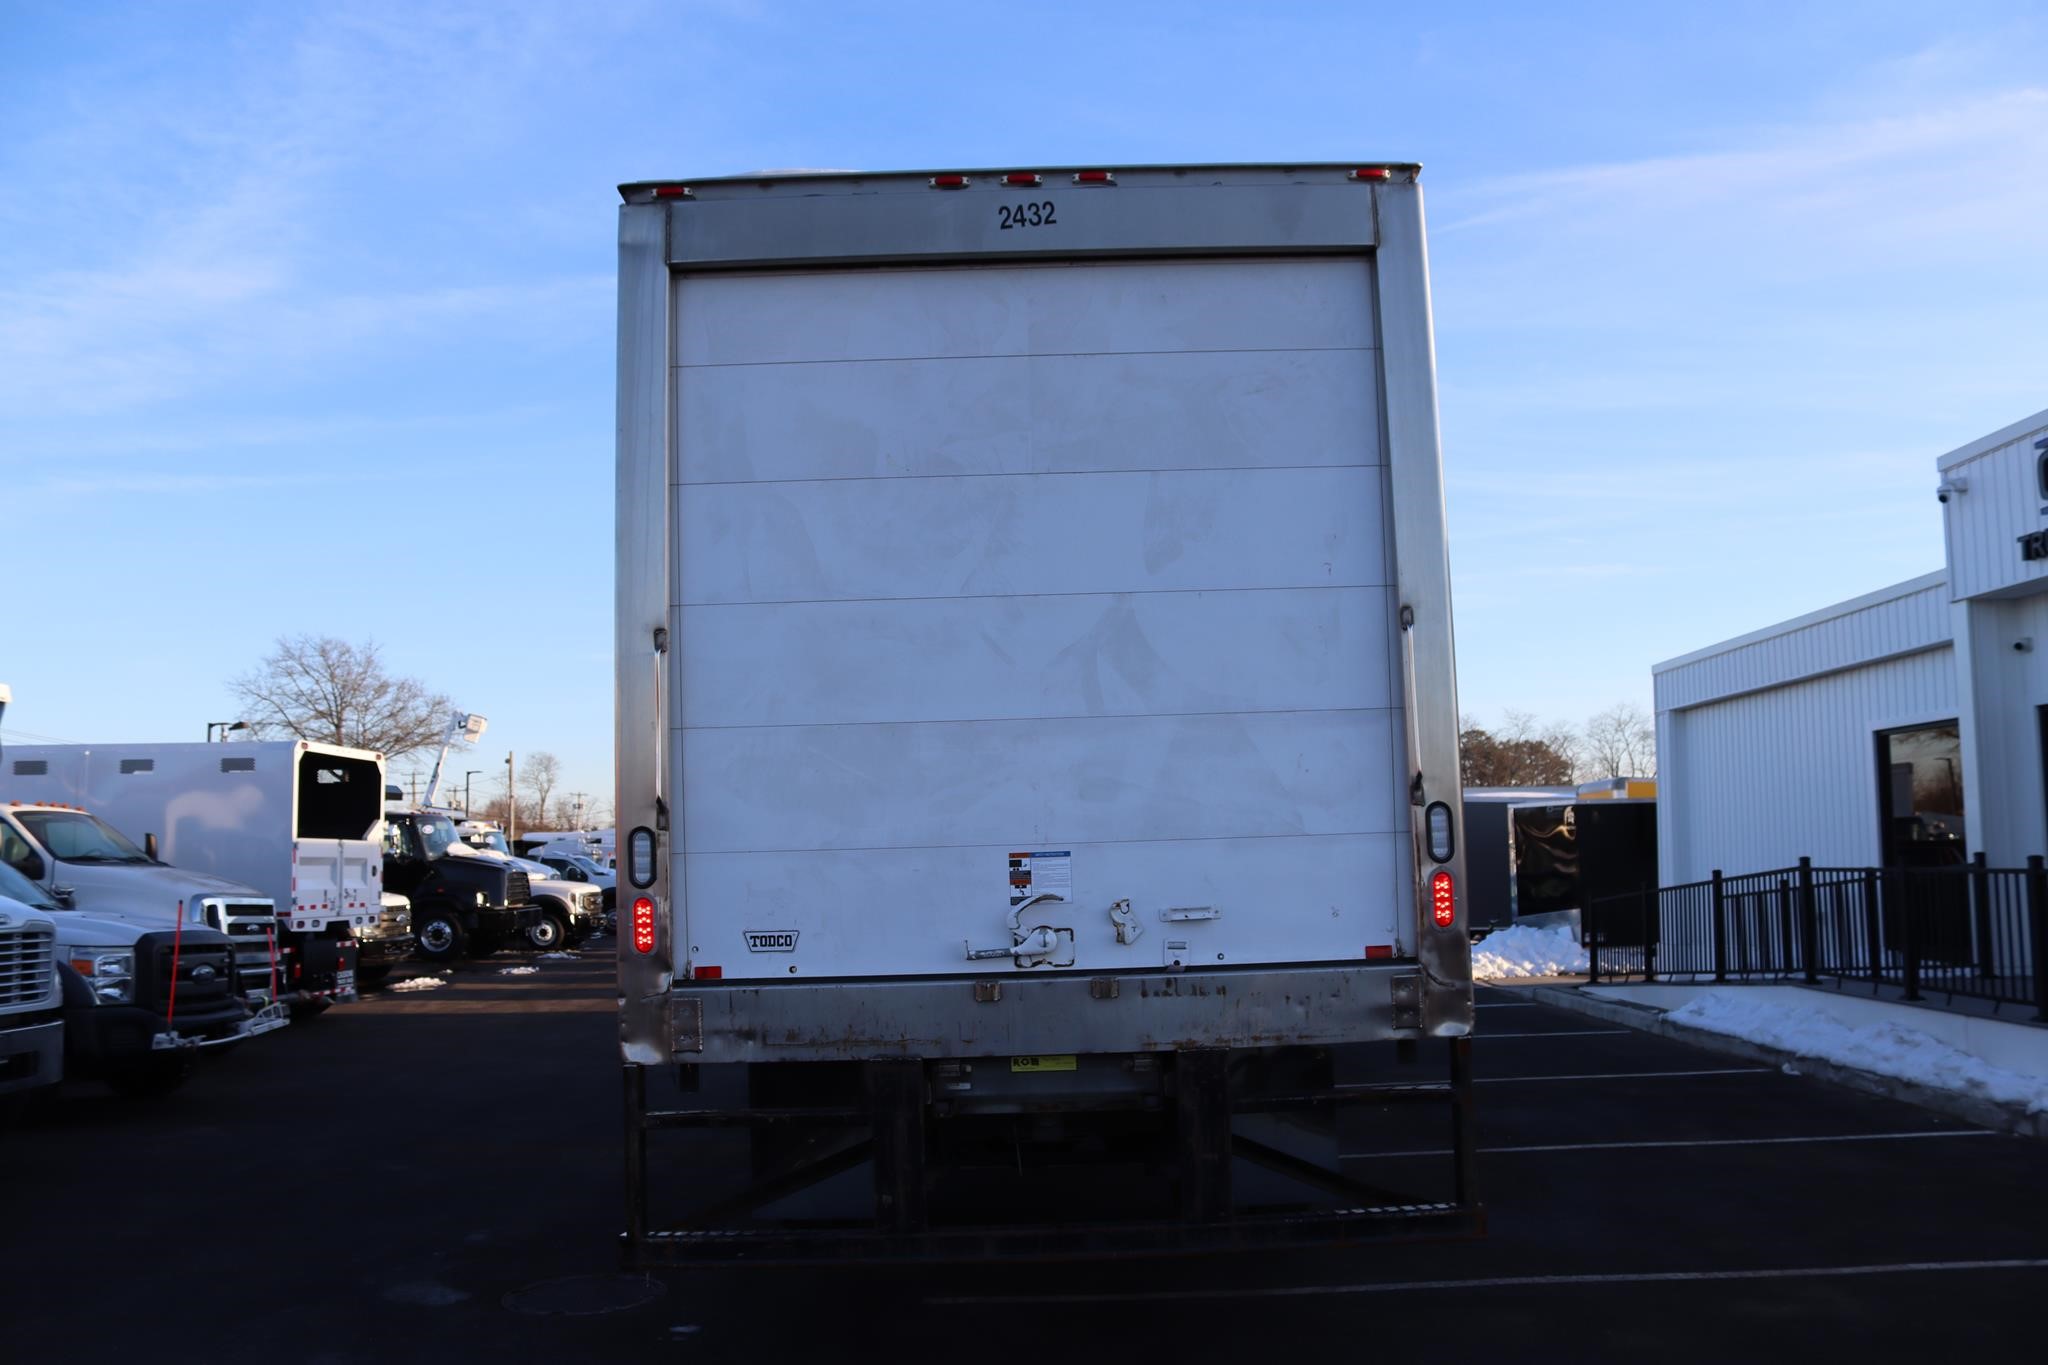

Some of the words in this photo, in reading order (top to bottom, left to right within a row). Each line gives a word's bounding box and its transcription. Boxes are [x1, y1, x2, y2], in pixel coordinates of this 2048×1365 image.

[998, 201, 1057, 230] 2432
[2017, 529, 2048, 561] TR
[749, 934, 793, 948] TODCO
